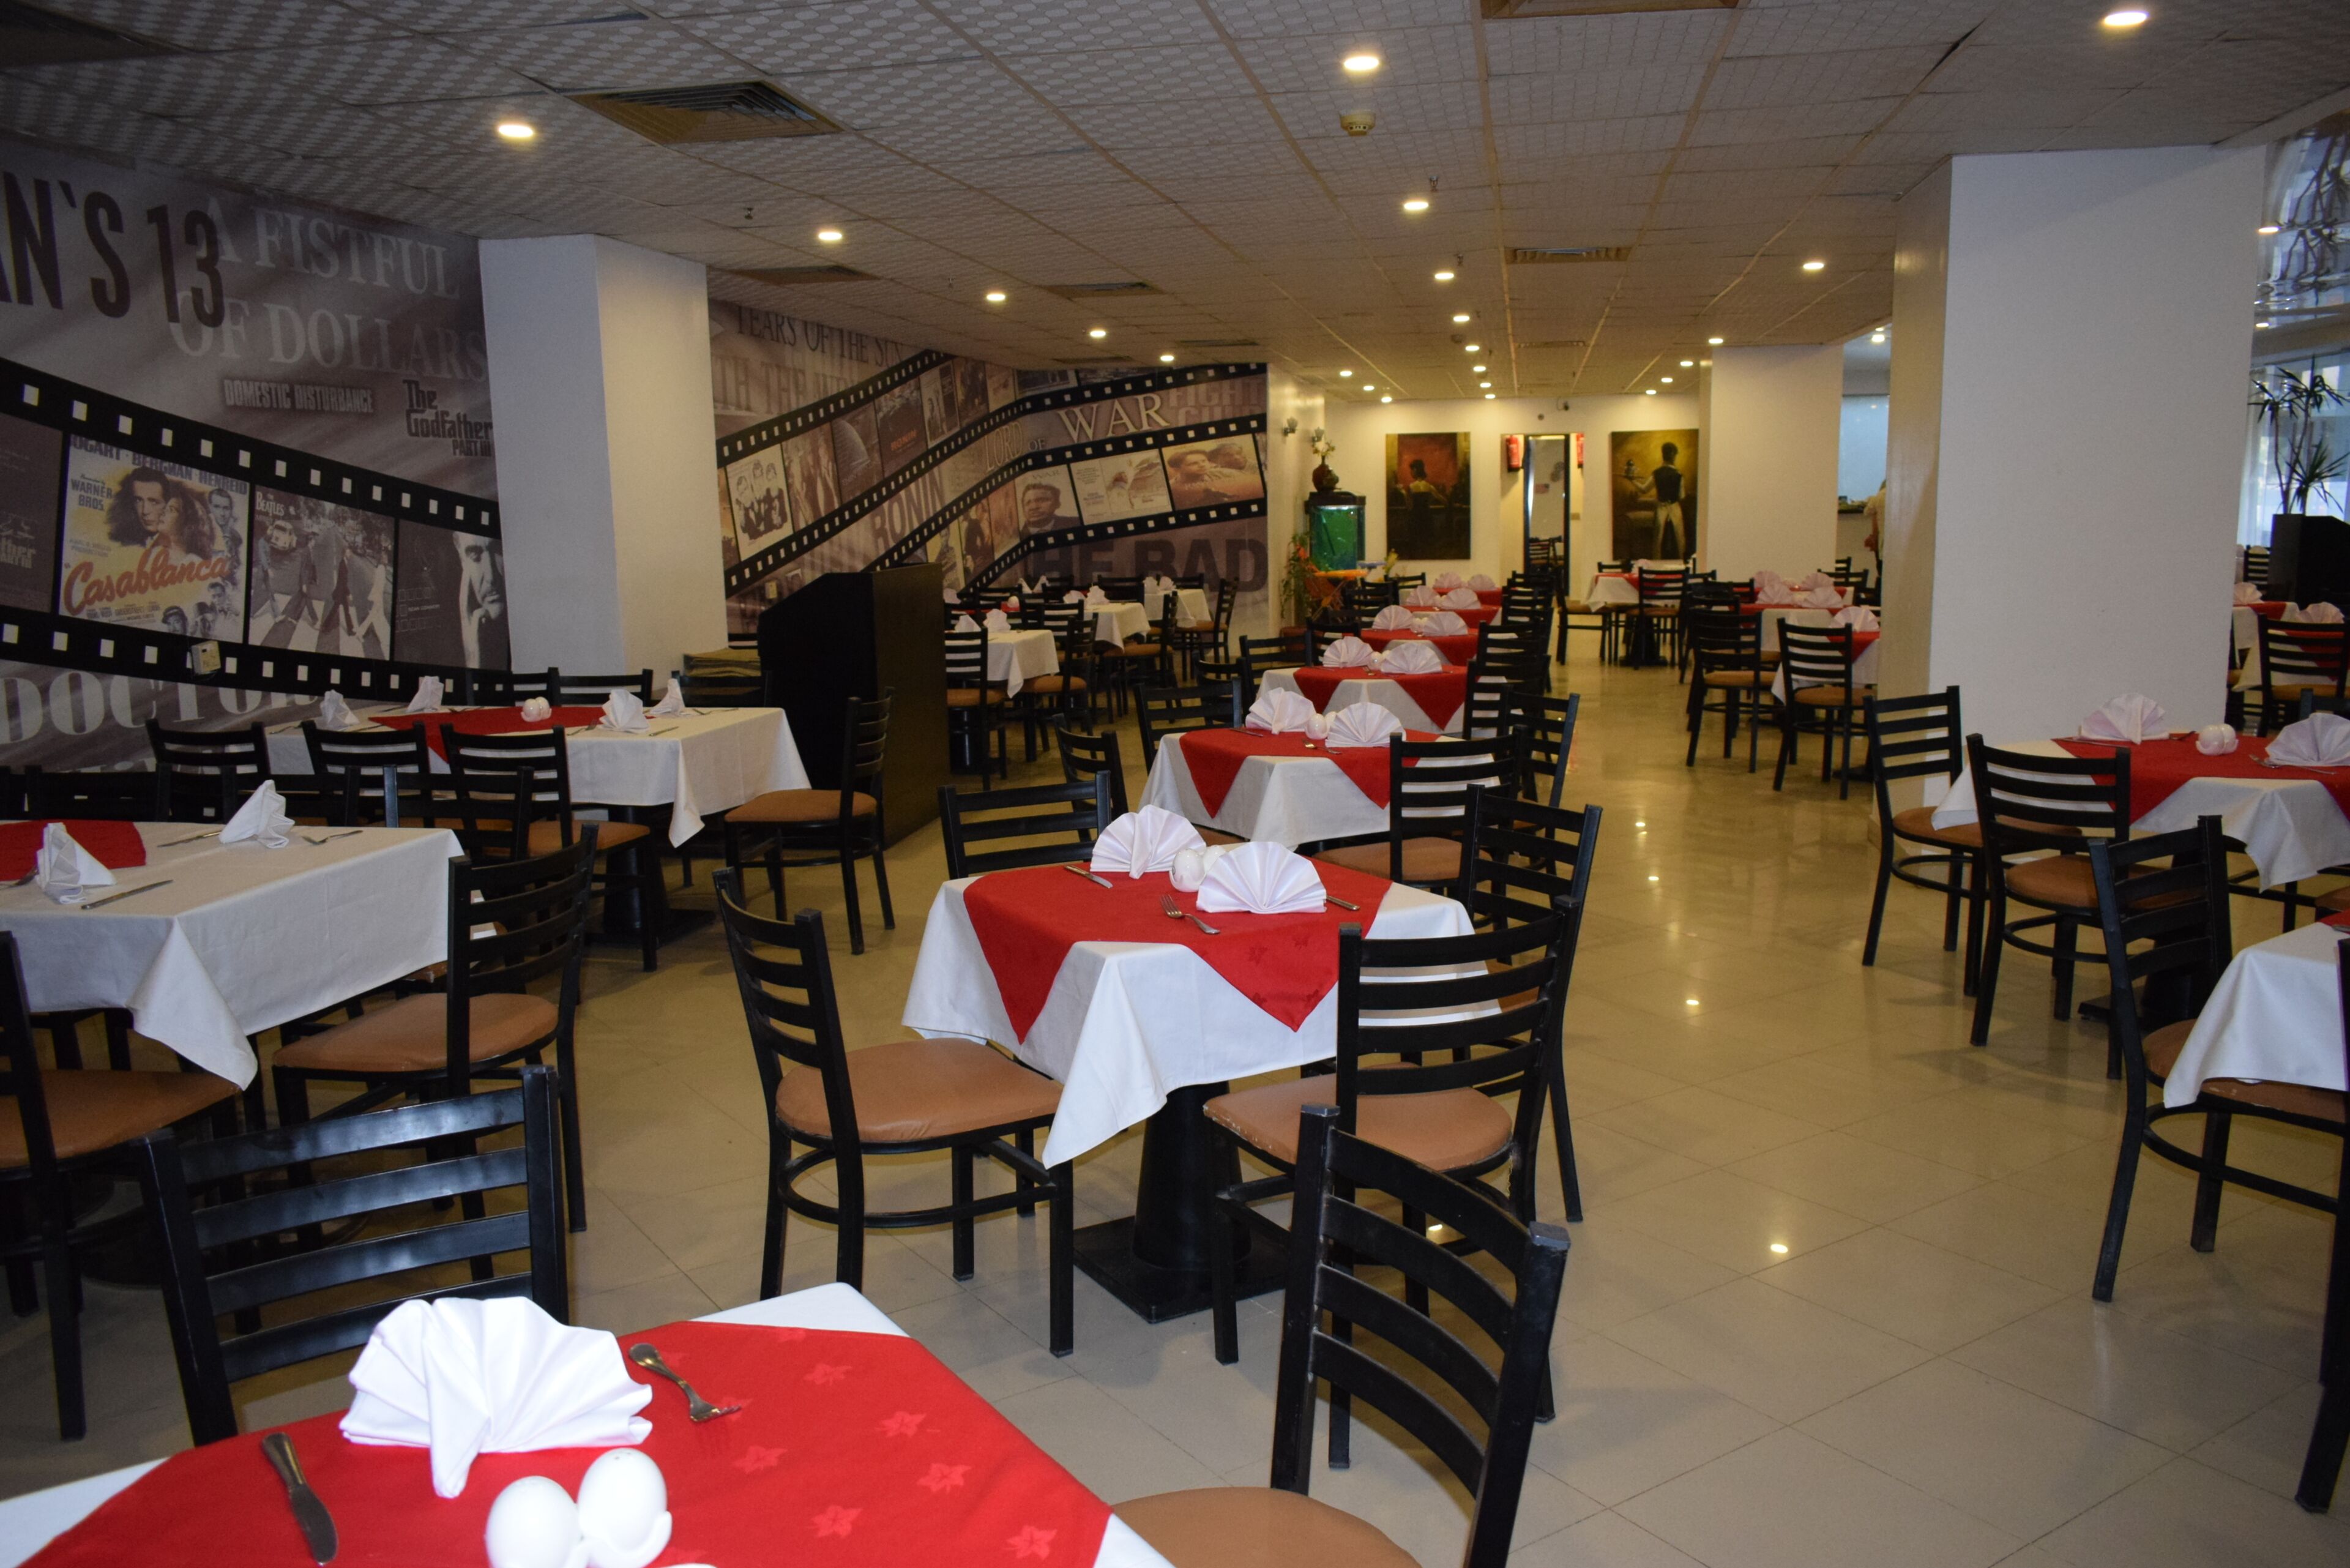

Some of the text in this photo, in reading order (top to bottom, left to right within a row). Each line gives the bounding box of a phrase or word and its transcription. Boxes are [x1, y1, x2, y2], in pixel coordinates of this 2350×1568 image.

[146, 204, 225, 329] 13
[253, 207, 460, 299] FISTFUL
[263, 302, 488, 383] DOLLARS
[736, 306, 797, 347] TEARS
[804, 321, 830, 354] OF
[838, 328, 869, 363] THE
[223, 378, 374, 414] DOMESTIC DISTURBANCE
[402, 379, 438, 409] The
[405, 409, 493, 439] Godfather
[452, 439, 479, 457] PART
[984, 392, 1171, 471] LORD OF WAR
[70, 479, 113, 499] WARNER
[255, 491, 285, 517] BEATLES
[871, 464, 947, 554] RONIN
[64, 541, 230, 616] Casablanca
[1134, 539, 1267, 592] BAD
